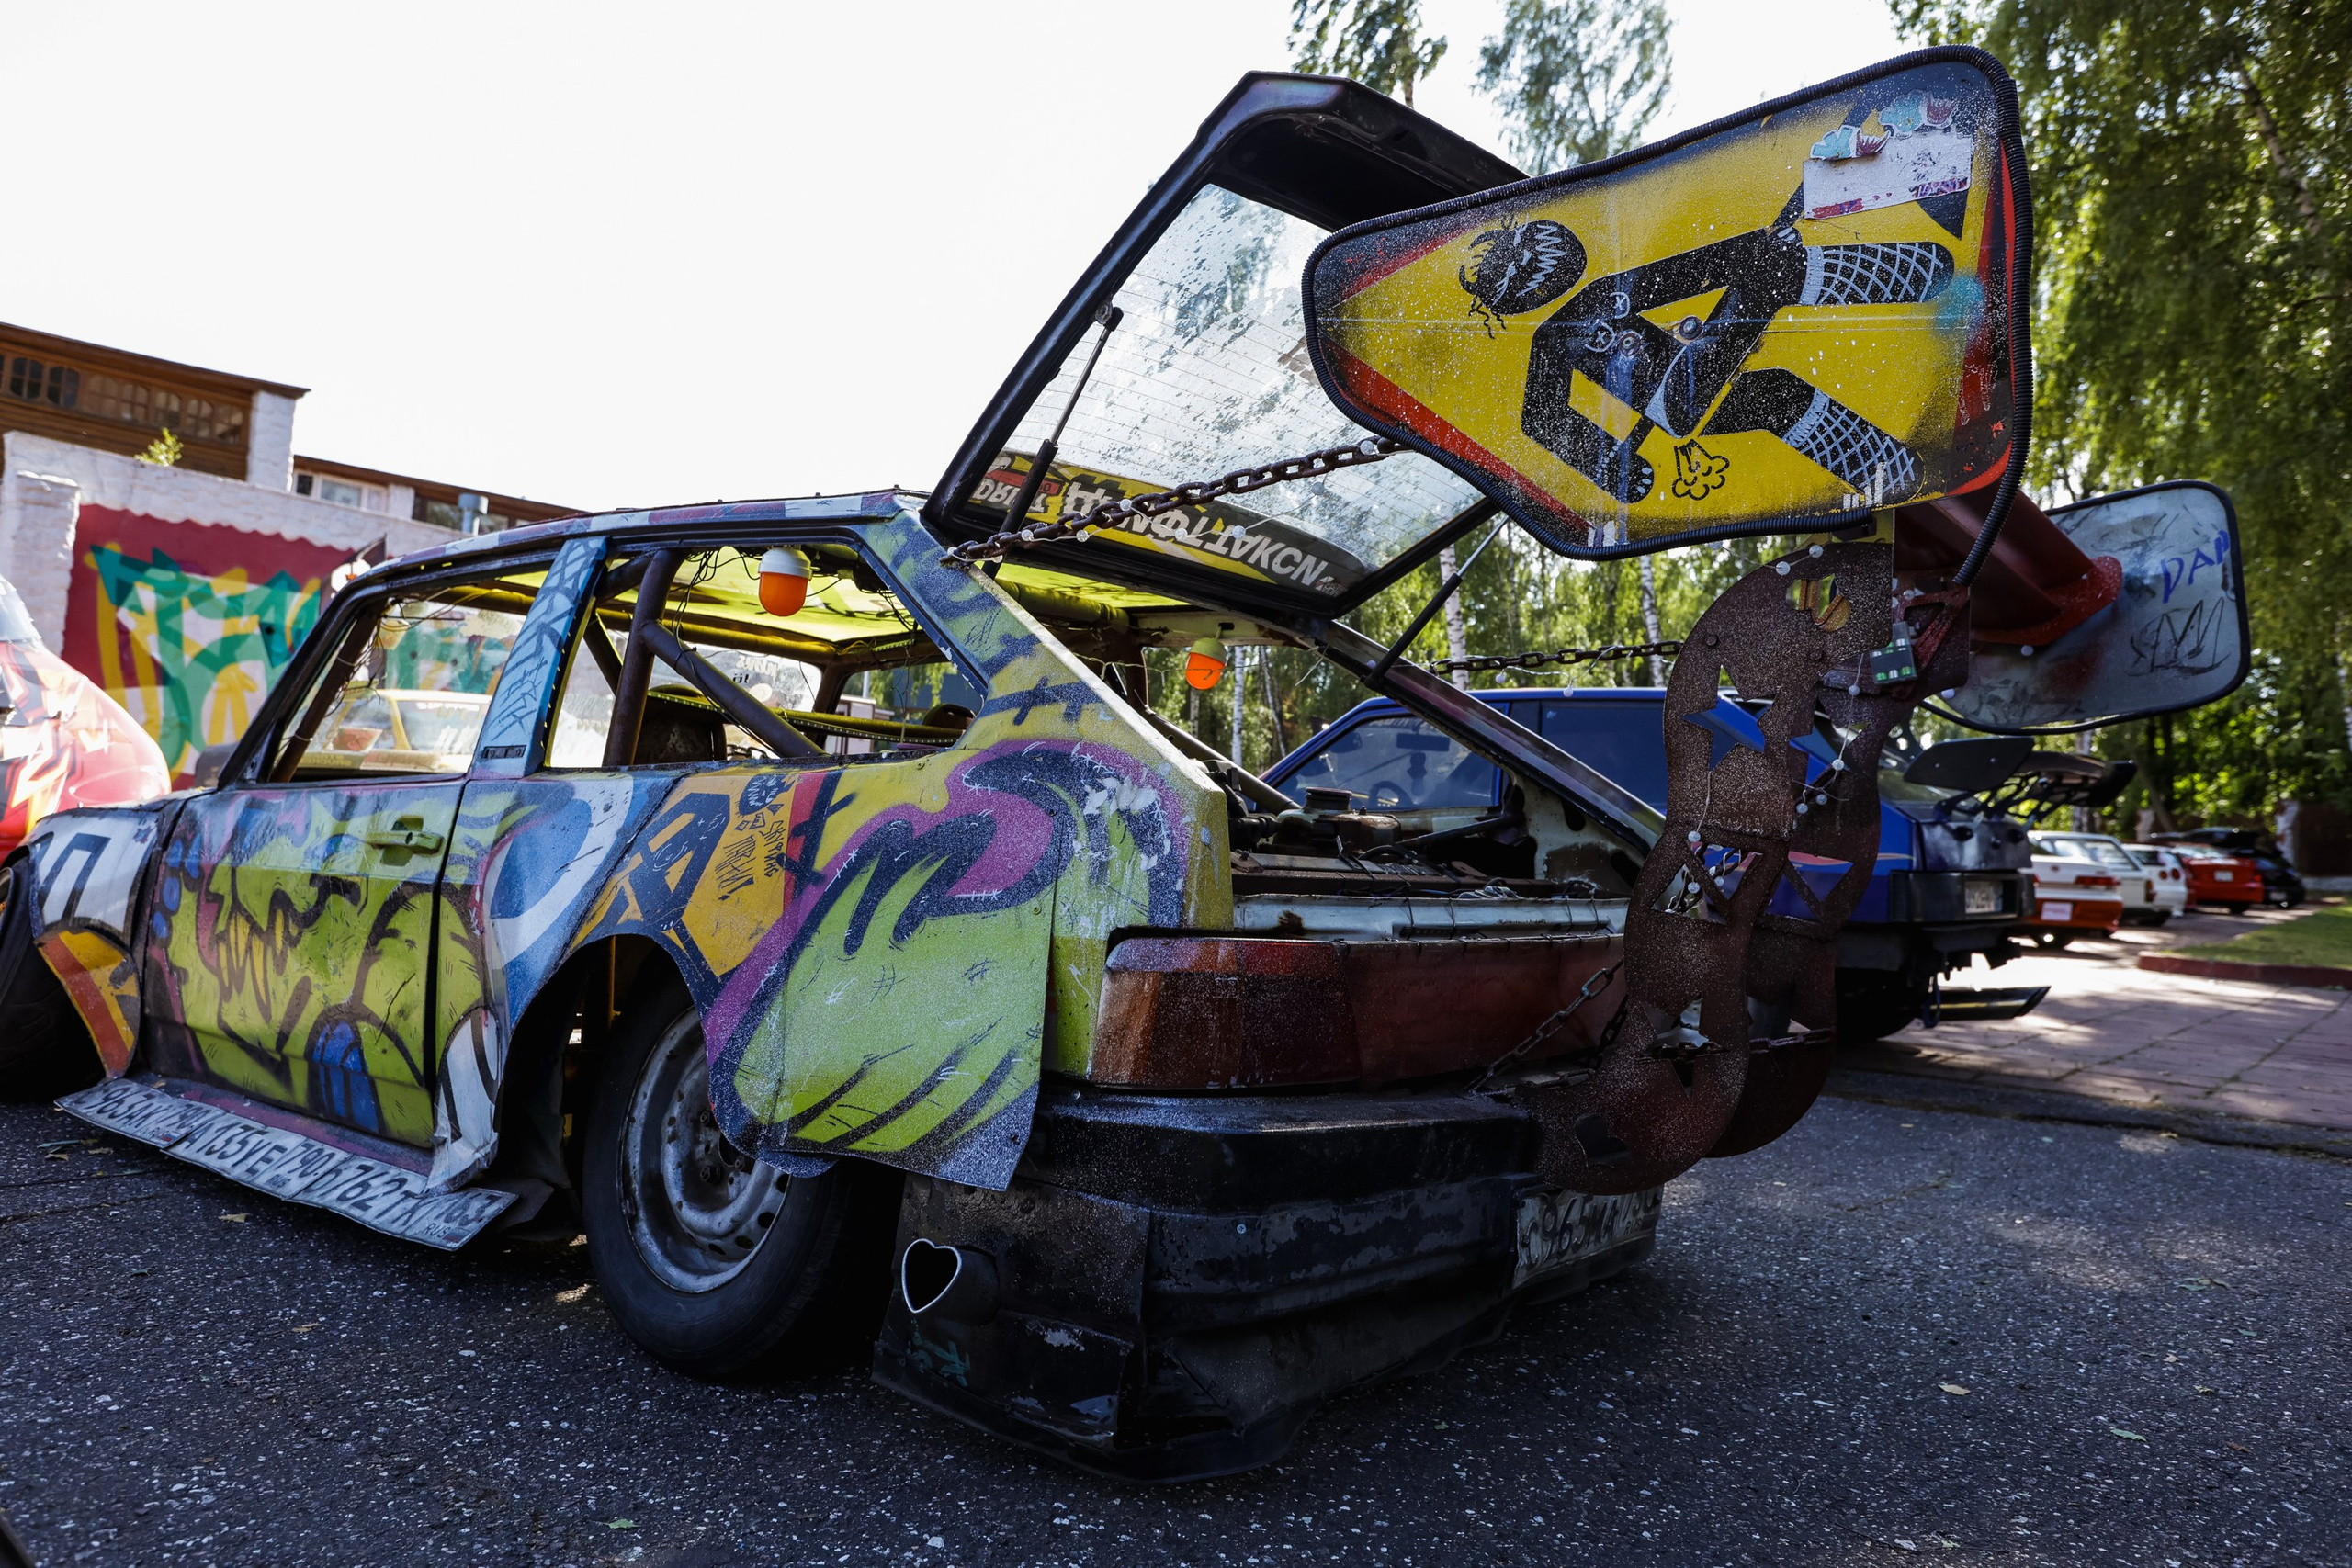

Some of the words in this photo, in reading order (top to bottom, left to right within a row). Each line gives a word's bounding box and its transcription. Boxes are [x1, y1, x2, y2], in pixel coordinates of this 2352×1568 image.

[274, 1142, 339, 1179] 790
[265, 1173, 292, 1189] RUS
[422, 1222, 453, 1240] RUS
